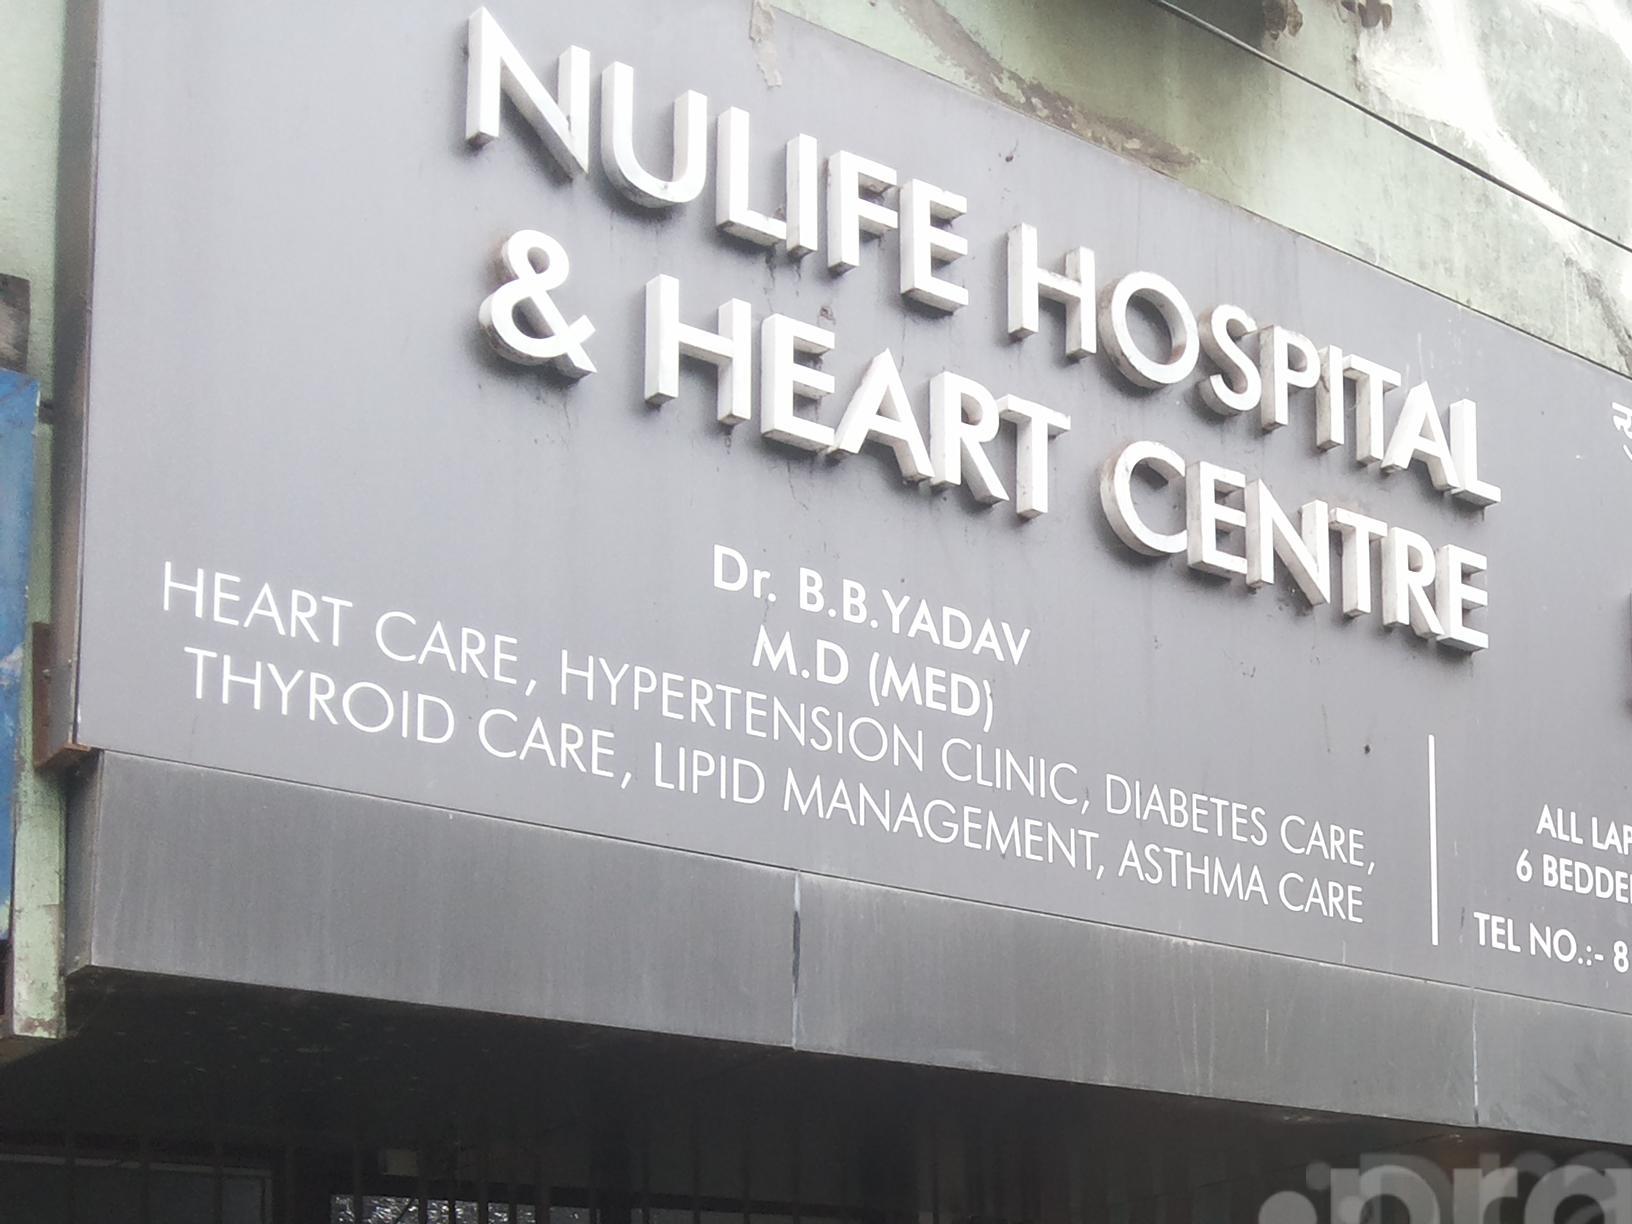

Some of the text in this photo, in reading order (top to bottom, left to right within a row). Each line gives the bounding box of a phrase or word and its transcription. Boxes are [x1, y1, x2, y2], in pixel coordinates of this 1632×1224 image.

[465, 5, 1501, 507] NULIFE HOSPITAL
[478, 229, 1489, 651] & HEART CENTRE
[713, 544, 1032, 667] Dr. B.B.YADAV
[162, 561, 1376, 876] HEART CARE, HYPERTENSION CLINIC, DIABETES CARE,
[751, 624, 994, 733] M.D (MED)
[184, 646, 1364, 924] THYROID CARE, LIPID MANAGEMENT, ASTHMA CARE
[1536, 803, 1584, 845] ALL
[1515, 848, 1534, 883] 6
[1473, 911, 1521, 953] TEL
